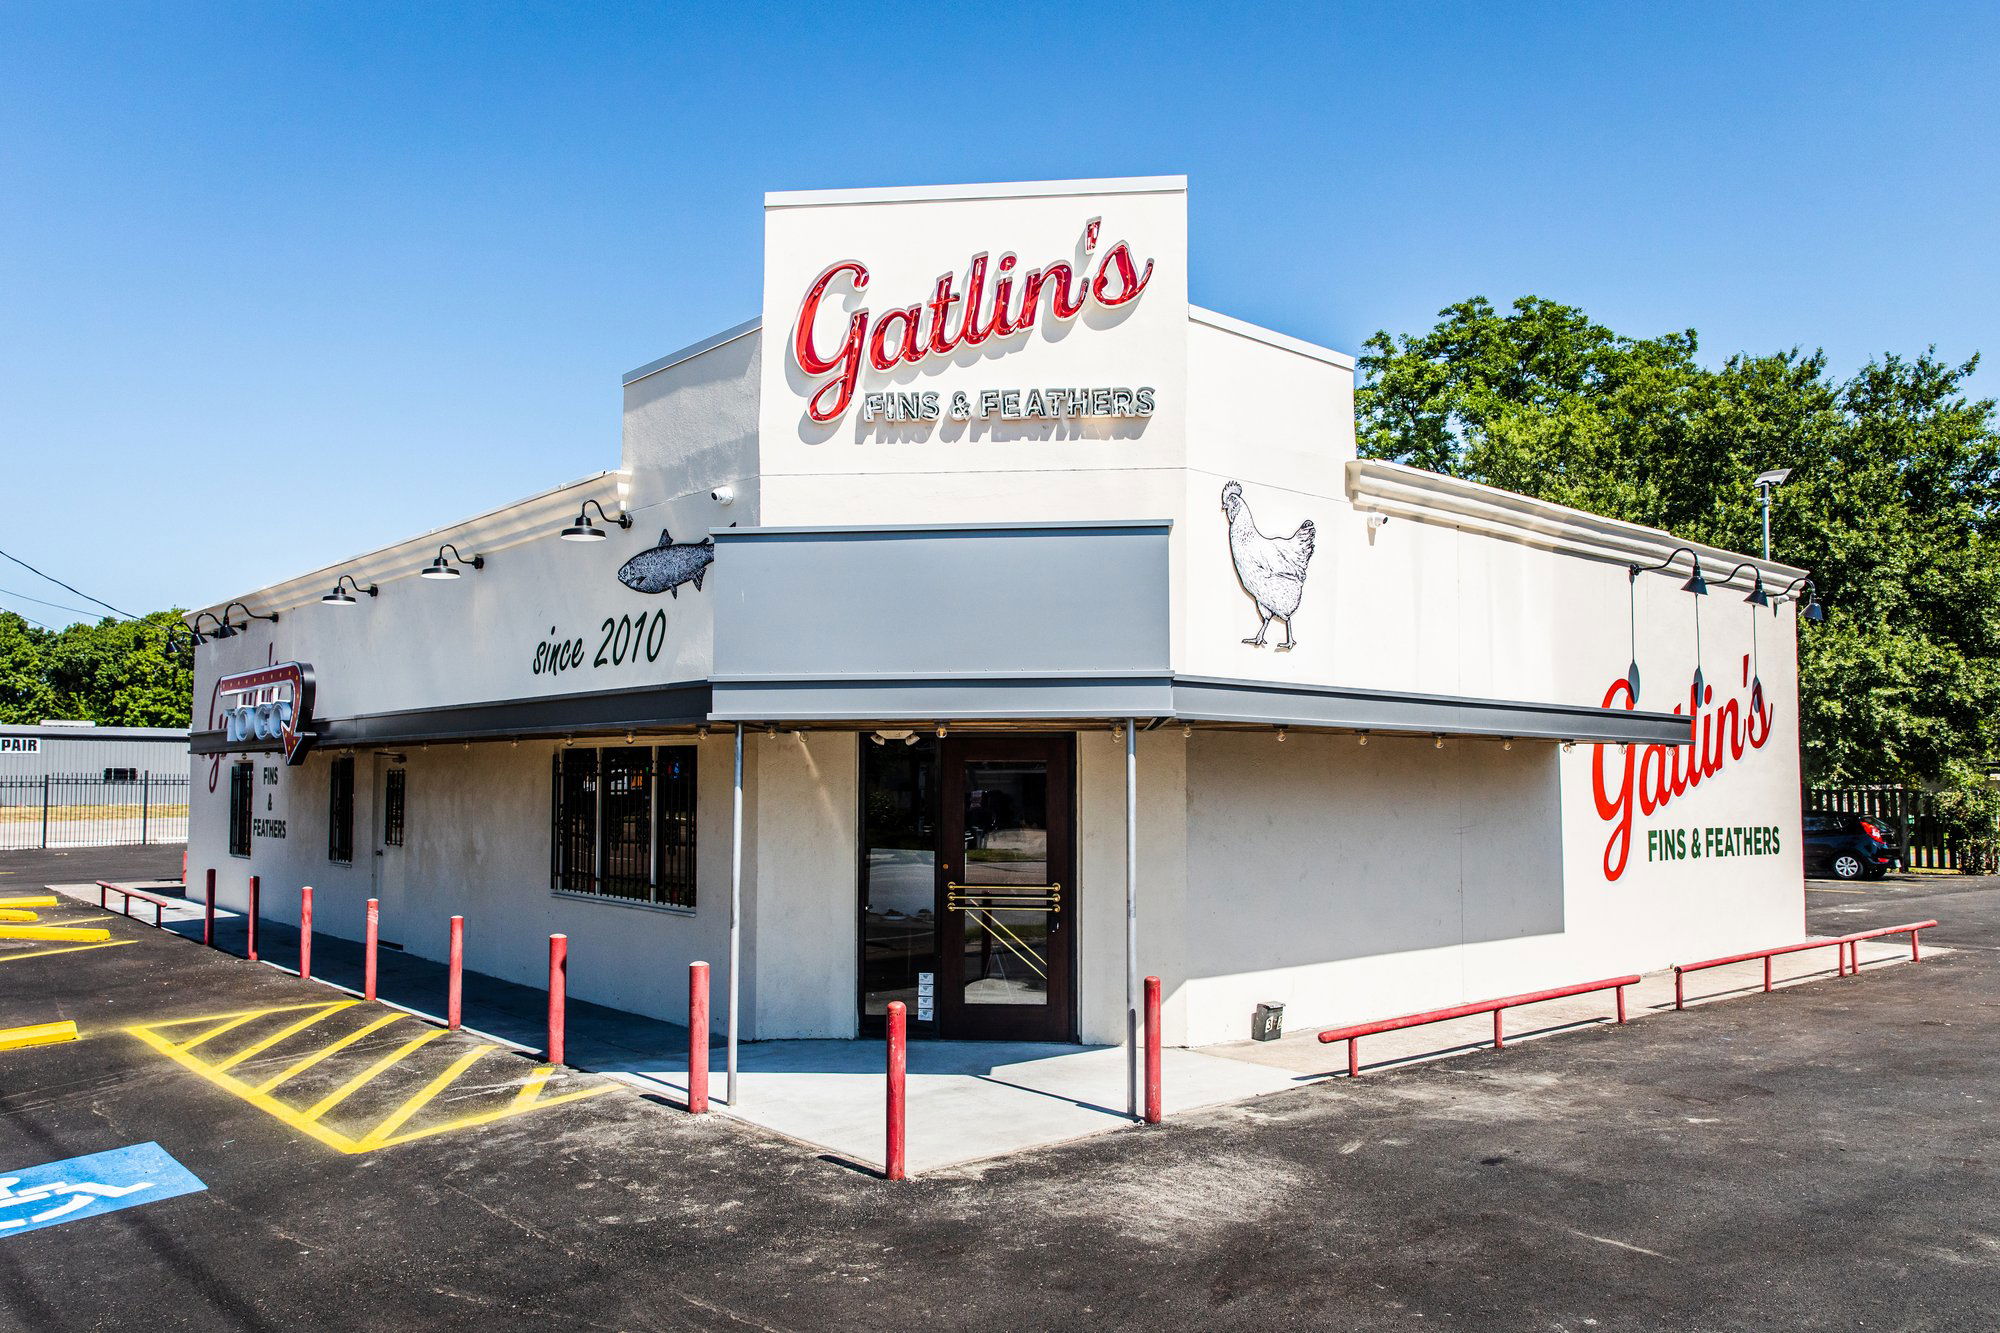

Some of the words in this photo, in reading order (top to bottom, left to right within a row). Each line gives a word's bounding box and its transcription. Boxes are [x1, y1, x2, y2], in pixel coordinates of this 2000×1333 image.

[793, 216, 1155, 424] Gatlin's
[864, 391, 940, 422] FINS
[949, 391, 970, 421] &
[981, 386, 1156, 420] FEATHERS
[532, 626, 585, 676] since
[593, 608, 667, 668] 2010
[1, 739, 37, 751] PAIR
[263, 767, 279, 785] FINS
[267, 793, 273, 811] &
[253, 818, 287, 839] FEATHERS
[1648, 828, 1686, 862] FINS
[1691, 828, 1701, 859] &
[1706, 826, 1781, 858] FEATHERS
